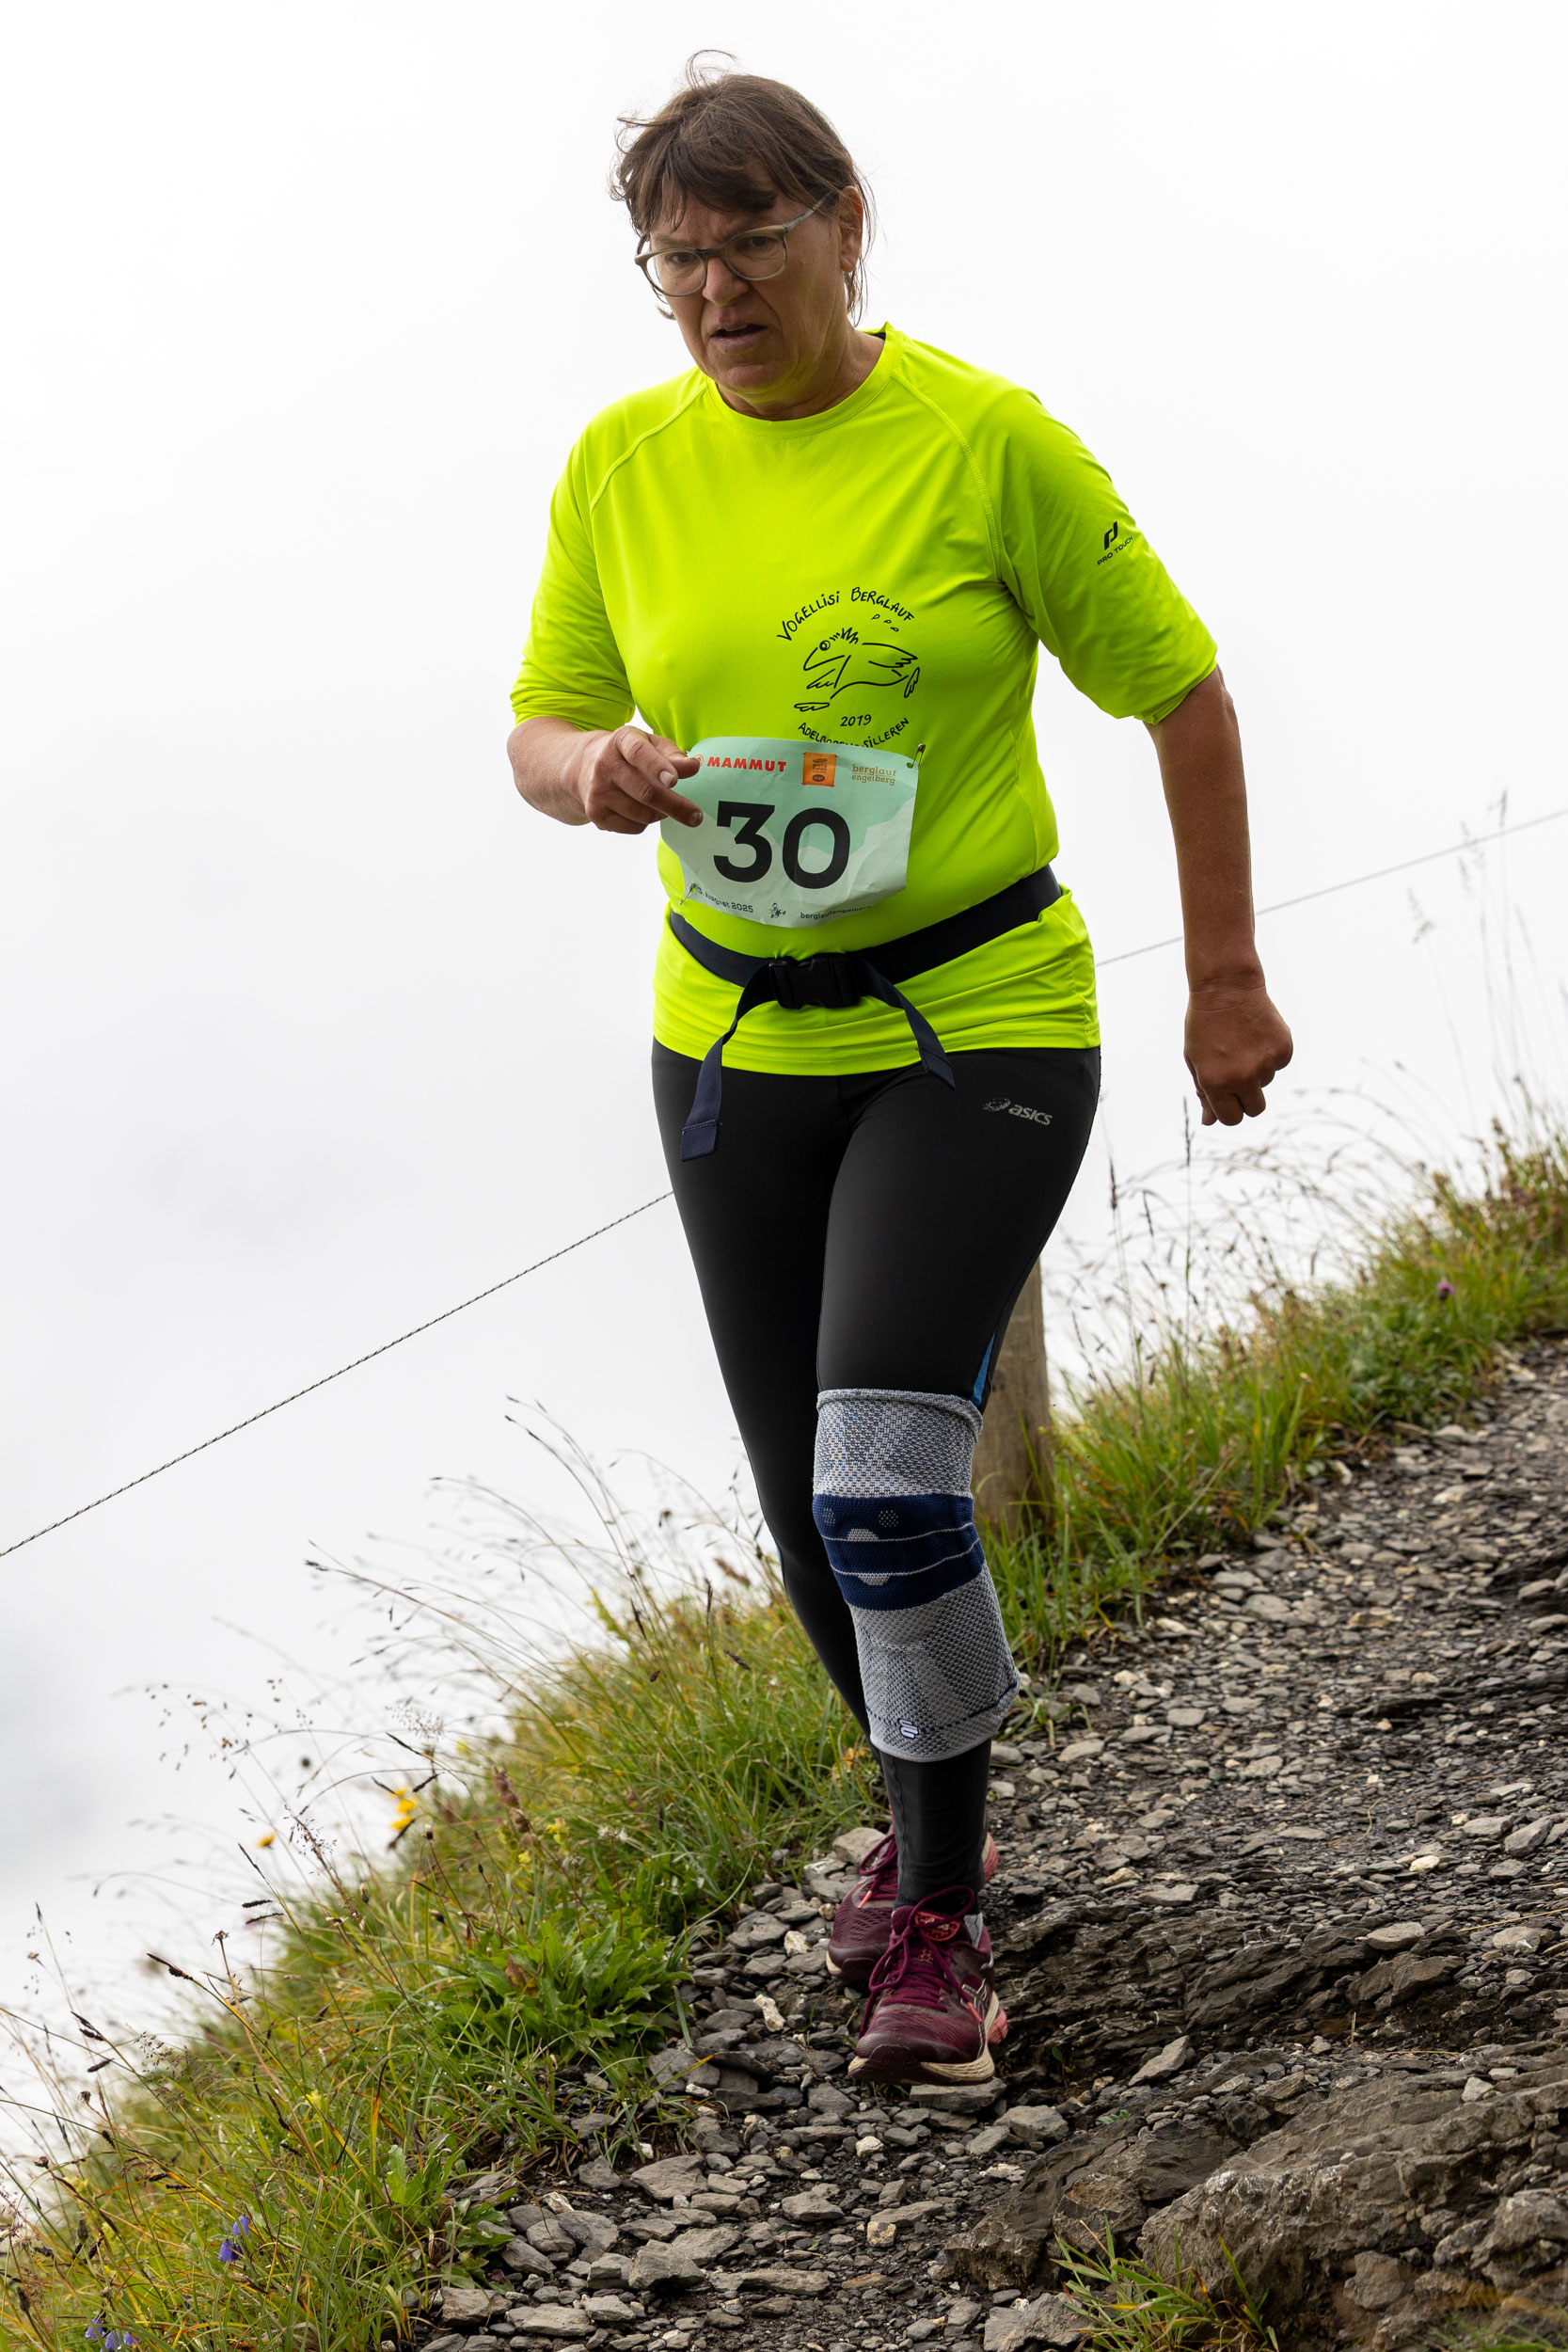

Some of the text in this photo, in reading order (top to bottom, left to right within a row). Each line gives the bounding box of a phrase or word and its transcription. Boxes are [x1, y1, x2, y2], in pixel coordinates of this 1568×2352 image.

[1097, 535, 1133, 566] PRO TOUCH
[850, 586, 915, 622] BERGLAUF
[840, 714, 872, 727] 2019
[706, 756, 787, 772] MAMMUT
[851, 764, 897, 777] berglauf
[851, 773, 896, 787] engelberg
[713, 800, 851, 890] 30
[731, 901, 754, 914] 2025
[1008, 1104, 1053, 1126] asics
